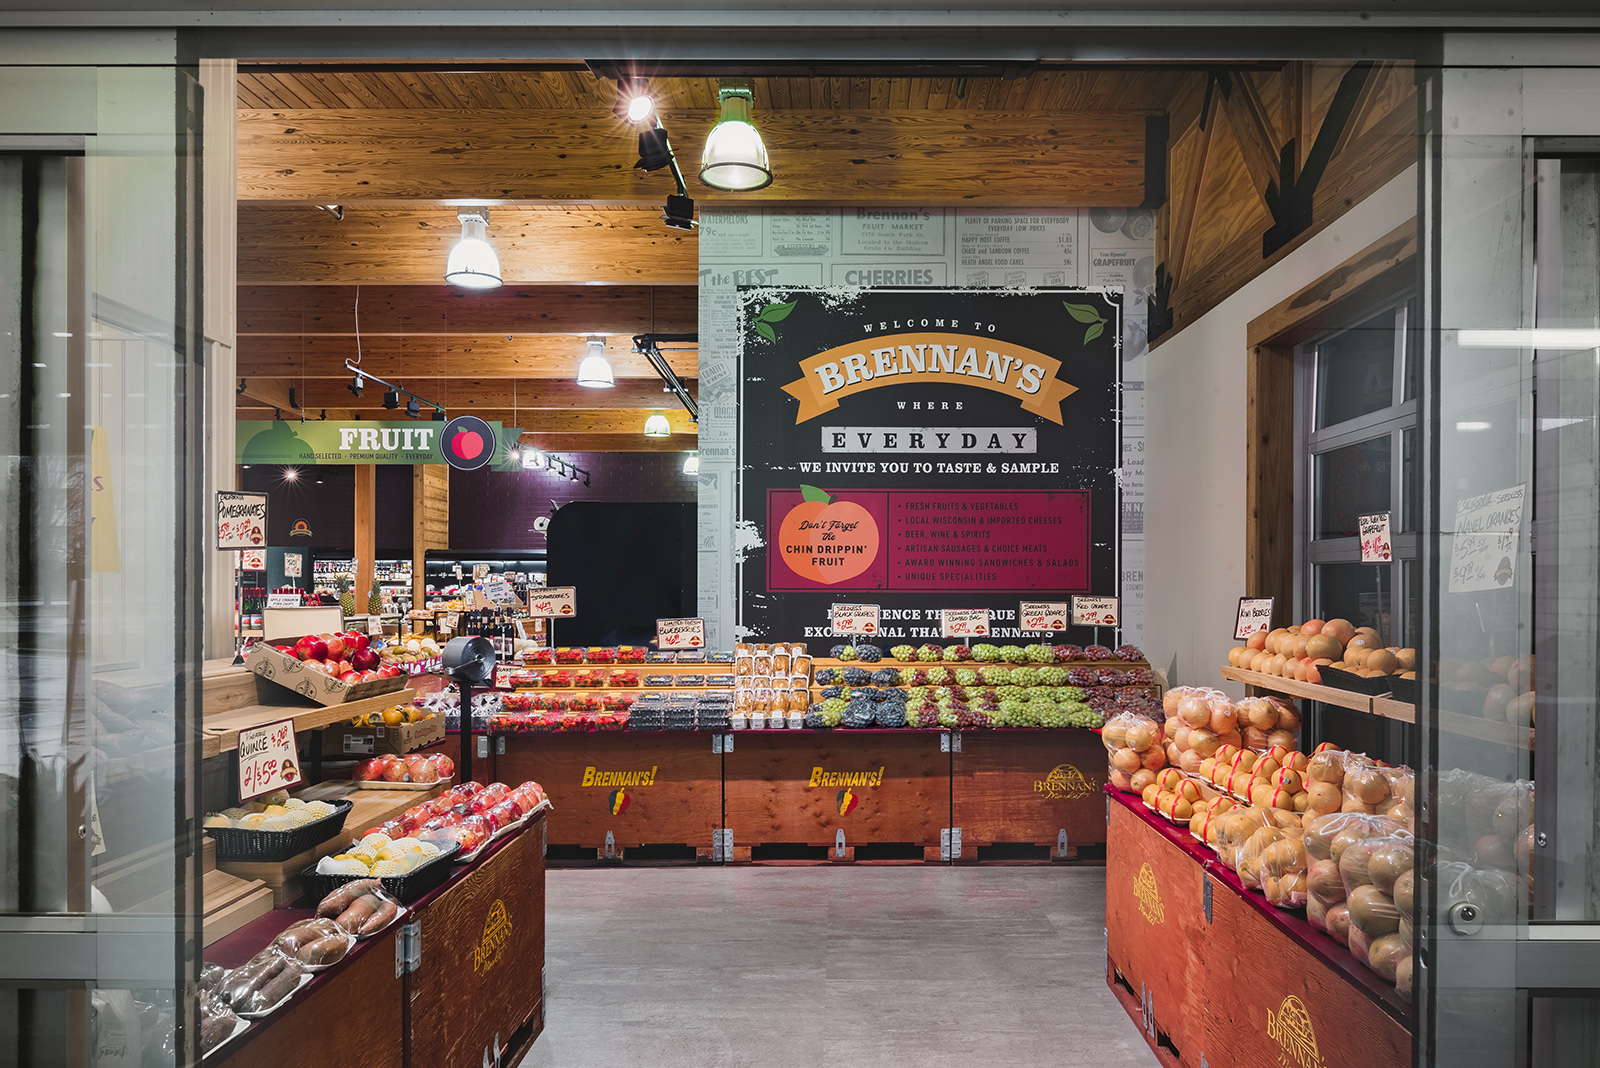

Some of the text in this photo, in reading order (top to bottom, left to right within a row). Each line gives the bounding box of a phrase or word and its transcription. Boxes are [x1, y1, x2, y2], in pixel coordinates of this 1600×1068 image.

[700, 214, 749, 225] WATERMELONS
[856, 207, 930, 221] Brennan's
[699, 227, 717, 236] 79c
[1093, 258, 1136, 267] GRAPEFRUIT
[733, 269, 779, 286] BEST
[845, 269, 934, 285] CHERRIES
[863, 319, 996, 333] WELCOME TO
[814, 344, 1047, 395] BRENNAN'S
[897, 401, 964, 410] WHERE
[338, 428, 433, 450] FRUIT
[831, 432, 1028, 449] EVERYDAY
[800, 462, 1060, 474] WE INVITE YOU TO TASTE & SAMPLE
[905, 502, 1019, 510] FRESH FRUITS & VEGETABLES
[798, 520, 859, 532] Don't Forget
[905, 516, 1062, 524] LOCAL WISCONSIN & IMPORTED CHEESES
[1456, 505, 1521, 538] NAVEL ORANGES
[905, 531, 928, 539] BEER,
[786, 545, 867, 554] CHIN DRIPPIN'
[905, 545, 1048, 553] ARTISAN SAUSAGES & CHOICE MEATS
[811, 557, 845, 566] FRUIT
[905, 559, 1080, 567] AWARD WINNING SANDWICHES & SALADS
[905, 573, 997, 581] UNIQUE SPECIALITIES
[1021, 609, 1066, 617] GREEN GRAPES
[659, 626, 701, 635] BLUEBERRIES
[240, 736, 269, 758] QUINCE
[582, 765, 658, 787] BRENNAN'S!
[808, 765, 885, 787] BRENNAN'S!
[1033, 777, 1100, 792] BRENNAN'S
[1133, 875, 1165, 923] BRENNAN'S
[474, 912, 513, 973] BRENNAN'S
